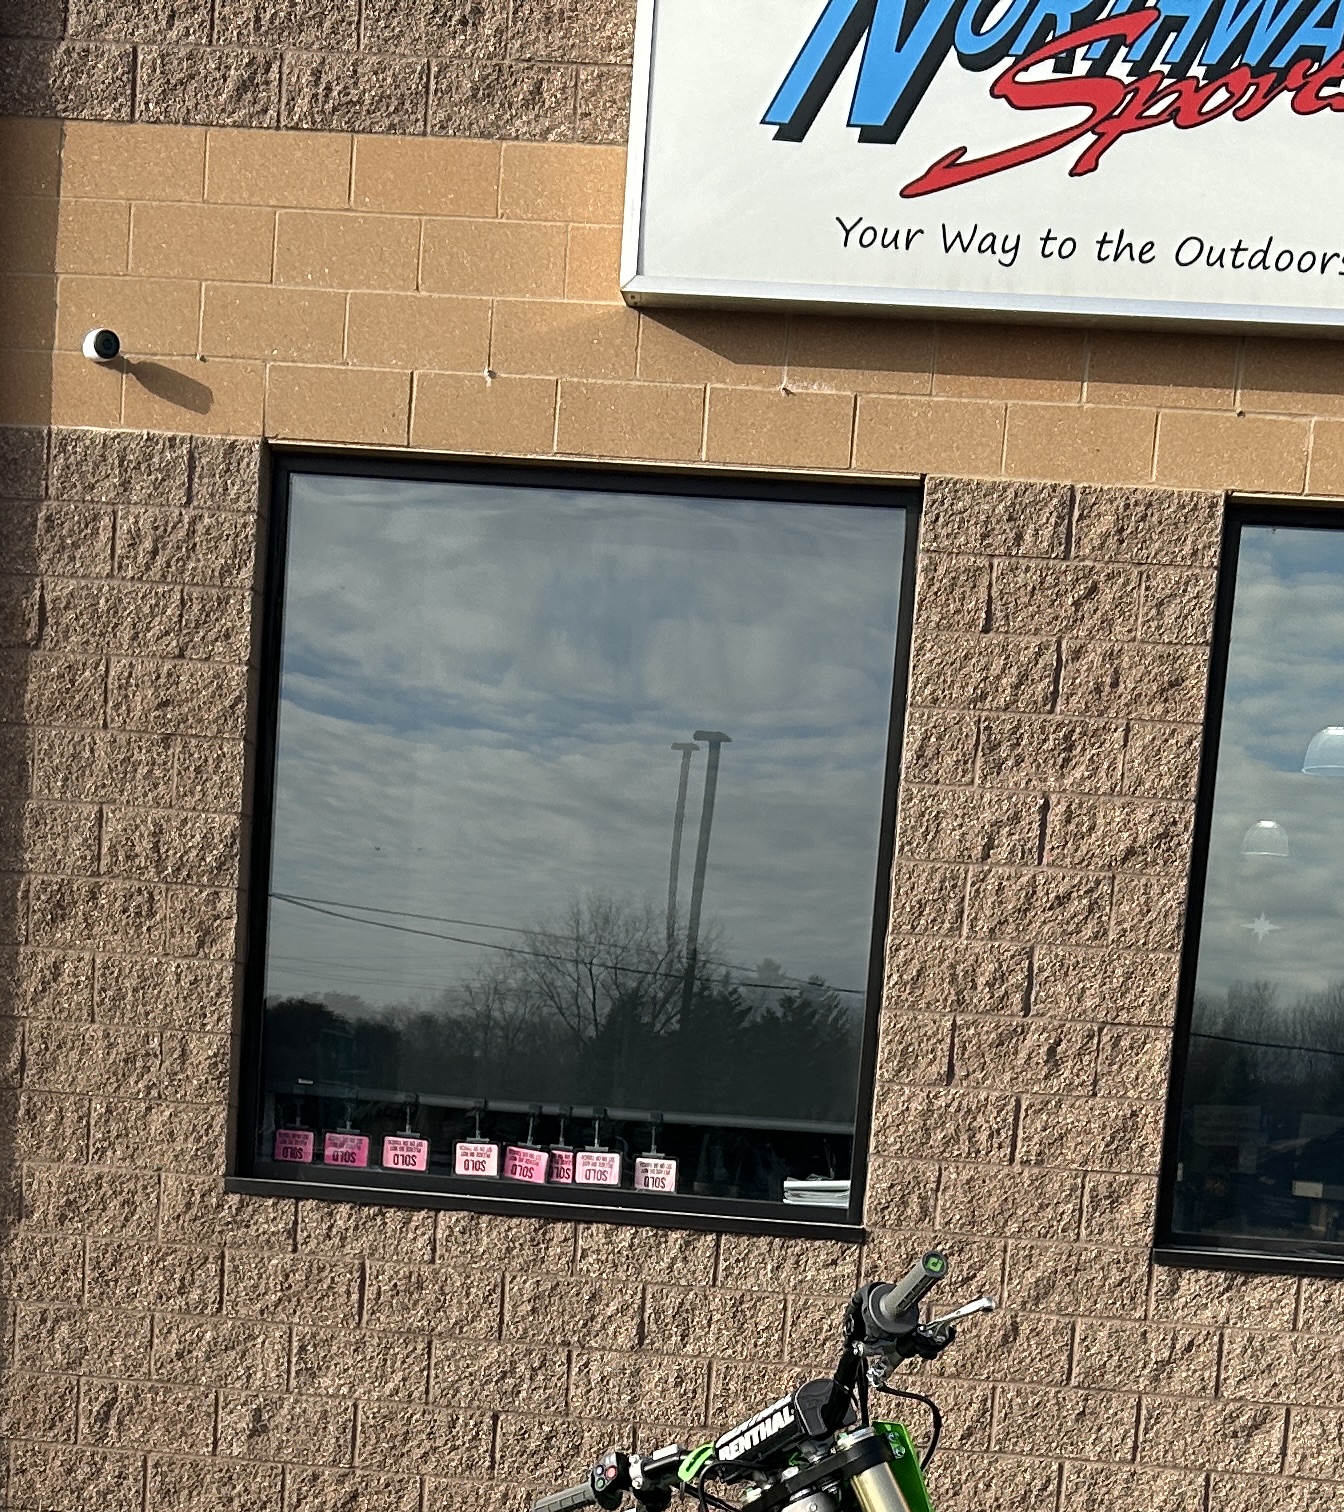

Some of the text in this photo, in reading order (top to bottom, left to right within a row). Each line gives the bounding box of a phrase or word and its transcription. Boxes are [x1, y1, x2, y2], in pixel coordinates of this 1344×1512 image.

[835, 216, 925, 251] Your
[941, 223, 1021, 268] Way
[1039, 228, 1077, 260] to
[1095, 228, 1157, 264] the
[332, 1150, 356, 1164] SOLD
[393, 1153, 417, 1167] SOLD
[464, 1159, 487, 1172] SOLD
[511, 1164, 534, 1179] SOLD
[585, 1168, 608, 1182] SOLD
[644, 1175, 666, 1189] SOLD
[718, 1405, 795, 1461] RENTHAL
